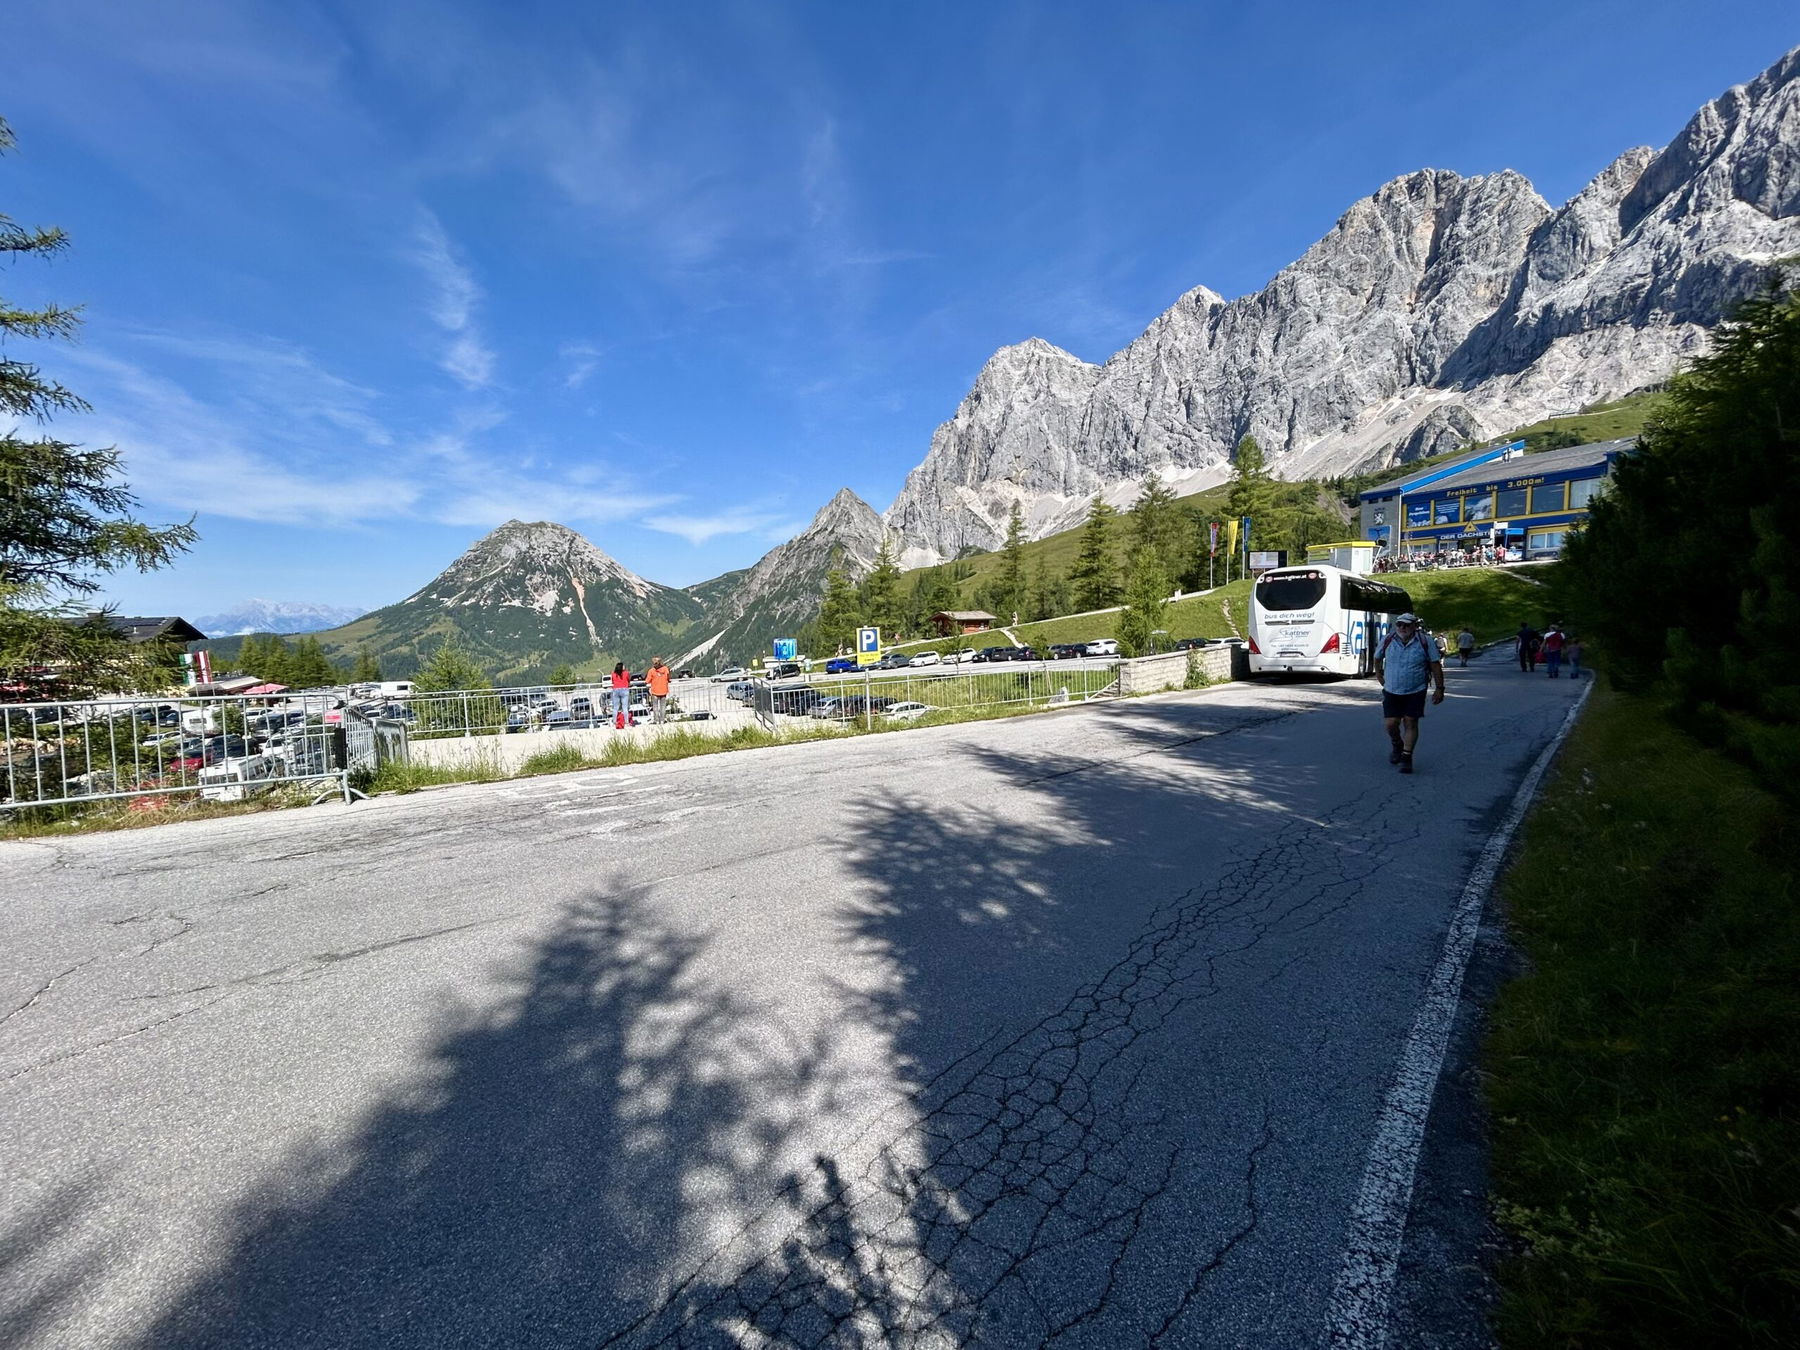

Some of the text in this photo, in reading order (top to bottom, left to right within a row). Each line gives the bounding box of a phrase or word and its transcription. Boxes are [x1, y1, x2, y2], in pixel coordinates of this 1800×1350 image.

[1446, 488, 1477, 497] Freiheit
[1457, 530, 1502, 539] DACHSTN
[862, 630, 875, 651] P
